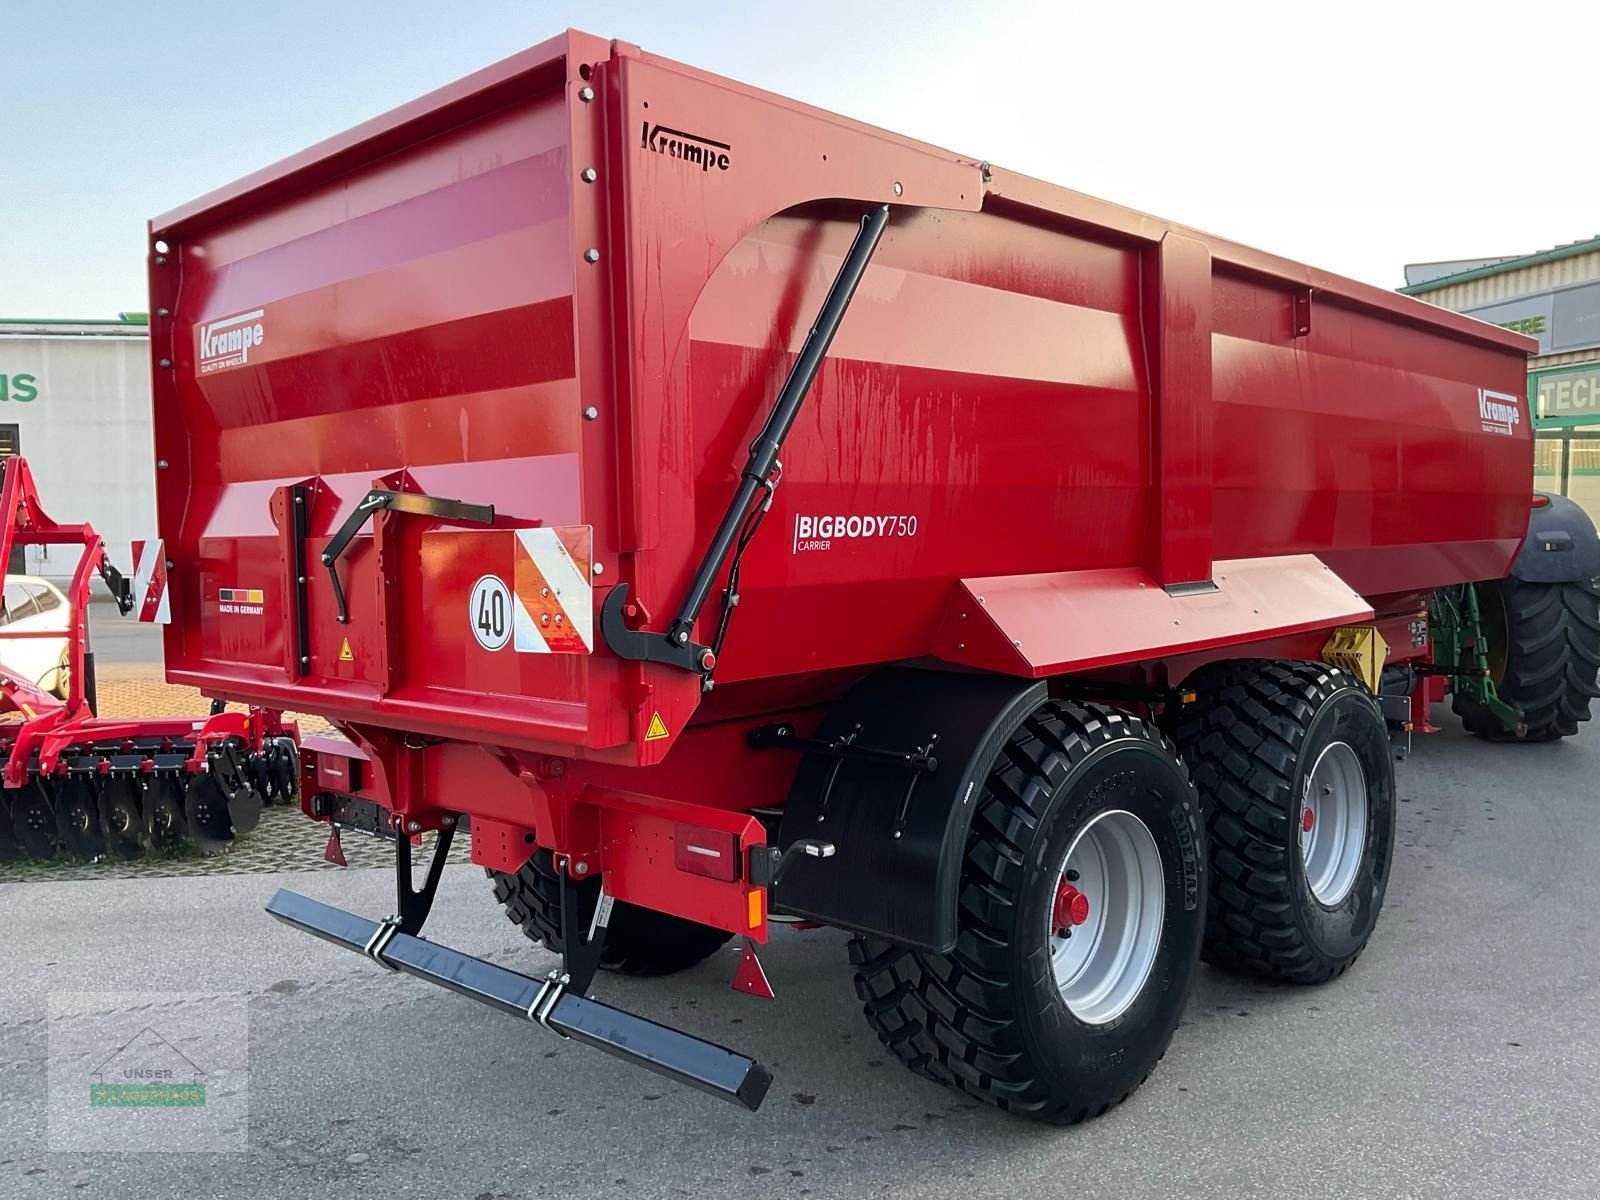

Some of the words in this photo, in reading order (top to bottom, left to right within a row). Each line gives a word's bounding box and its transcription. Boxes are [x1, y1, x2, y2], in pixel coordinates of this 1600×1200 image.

[641, 121, 730, 172] Krampe
[200, 309, 264, 363] Krampe
[1477, 388, 1519, 435] Krampe
[797, 540, 831, 551] CARRIER
[219, 604, 233, 613] MADE
[234, 604, 240, 613] IN
[240, 605, 264, 615] GERMANY
[478, 589, 504, 637] 40
